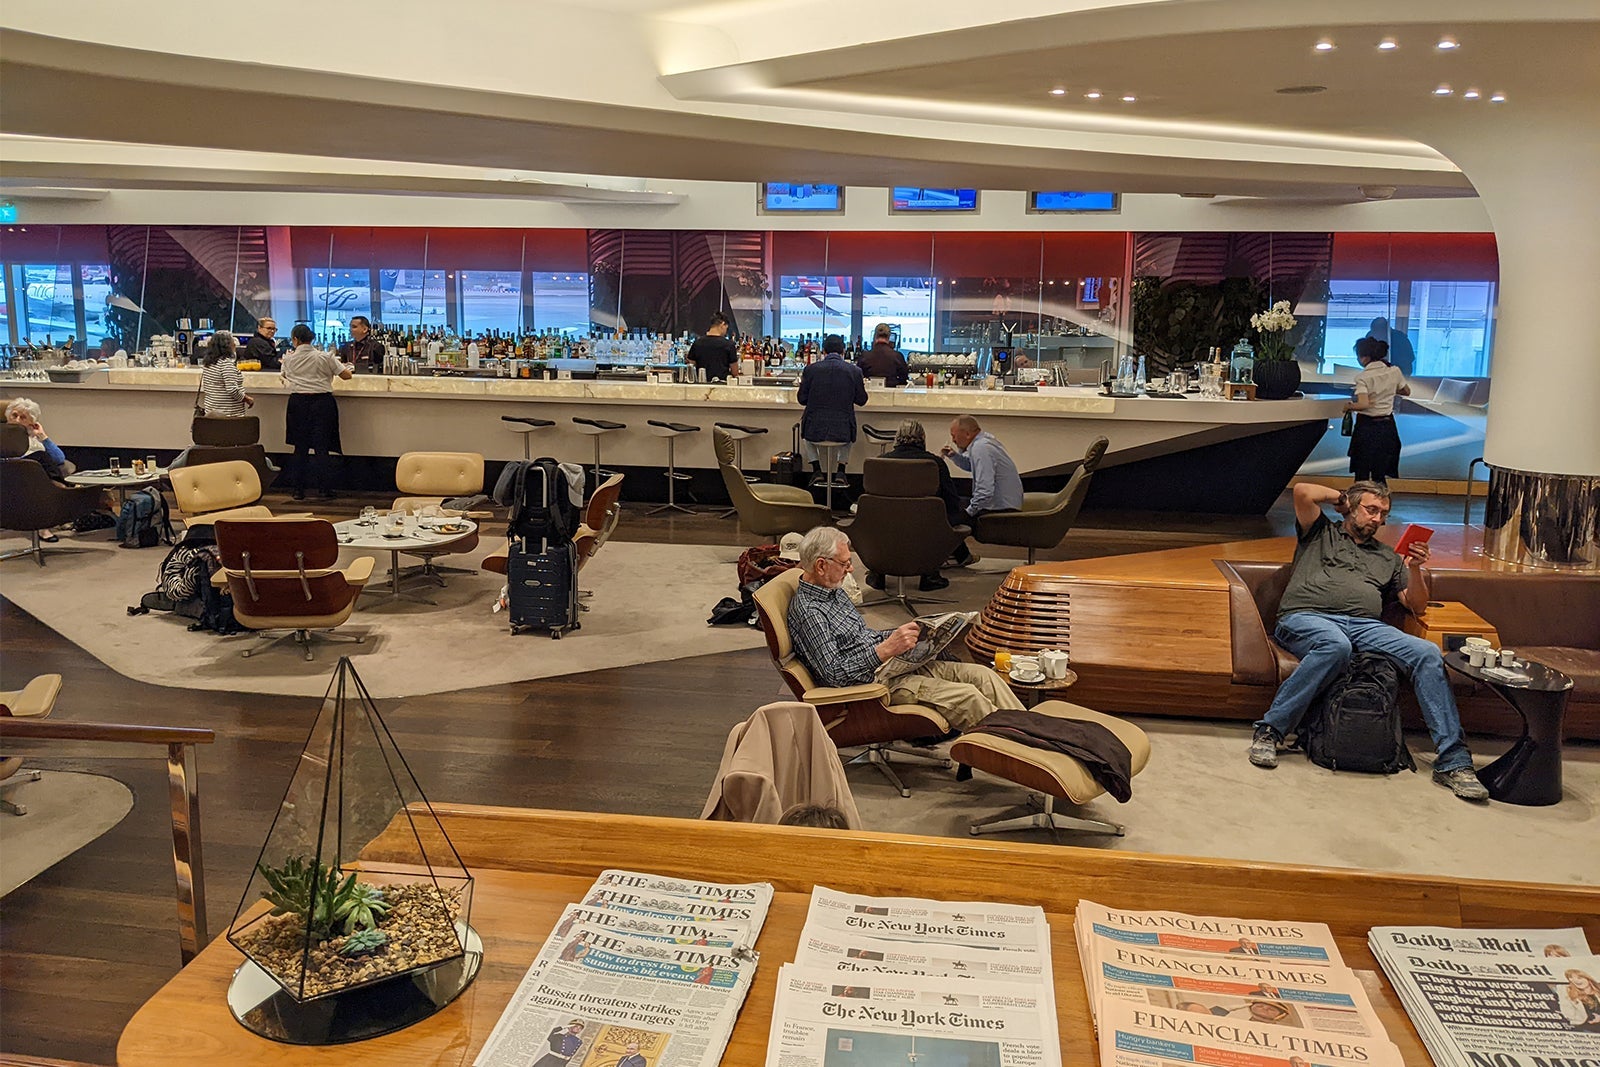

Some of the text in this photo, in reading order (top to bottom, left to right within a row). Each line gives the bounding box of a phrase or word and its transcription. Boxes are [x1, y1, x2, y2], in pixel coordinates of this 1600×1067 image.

[606, 873, 756, 901] THE TIMES
[597, 889, 751, 920] THE TIMES
[573, 908, 728, 939] THE TIM
[846, 916, 1006, 939] The New York Times
[1106, 911, 1304, 939] FINANCIAL TIMES
[580, 930, 741, 969] THE TIMES
[1390, 932, 1533, 953] Daily Mail
[584, 957, 639, 973] summer's
[640, 966, 659, 977] big
[659, 970, 696, 981] events
[588, 948, 615, 961] How
[616, 956, 628, 964] to
[628, 957, 659, 968] dress
[660, 961, 677, 971] for
[1116, 948, 1247, 977] FINANCIAL
[1249, 967, 1328, 985] TIMES
[1407, 956, 1473, 976] Daily
[1495, 963, 1553, 977] Mail
[1413, 973, 1535, 992] In her own words,
[1420, 982, 1556, 1001] night Angela Rayner
[530, 994, 577, 1011] against
[579, 1003, 629, 1019] western
[627, 1009, 676, 1027] targets
[537, 984, 577, 1001] Russia
[578, 992, 639, 1010] threatens
[638, 1002, 683, 1017] strikes
[1425, 991, 1551, 1010] laughed and joked
[1433, 1002, 1563, 1020] about comparisons
[822, 1002, 856, 1019] The
[858, 1006, 897, 1022] New
[901, 1009, 946, 1027] York
[949, 1012, 1006, 1030] Times
[1440, 1013, 1565, 1030] with Sharon Stone
[1118, 1032, 1176, 1049] Hungry bankers
[1133, 1010, 1369, 1062] FINANCIAL TIMES
